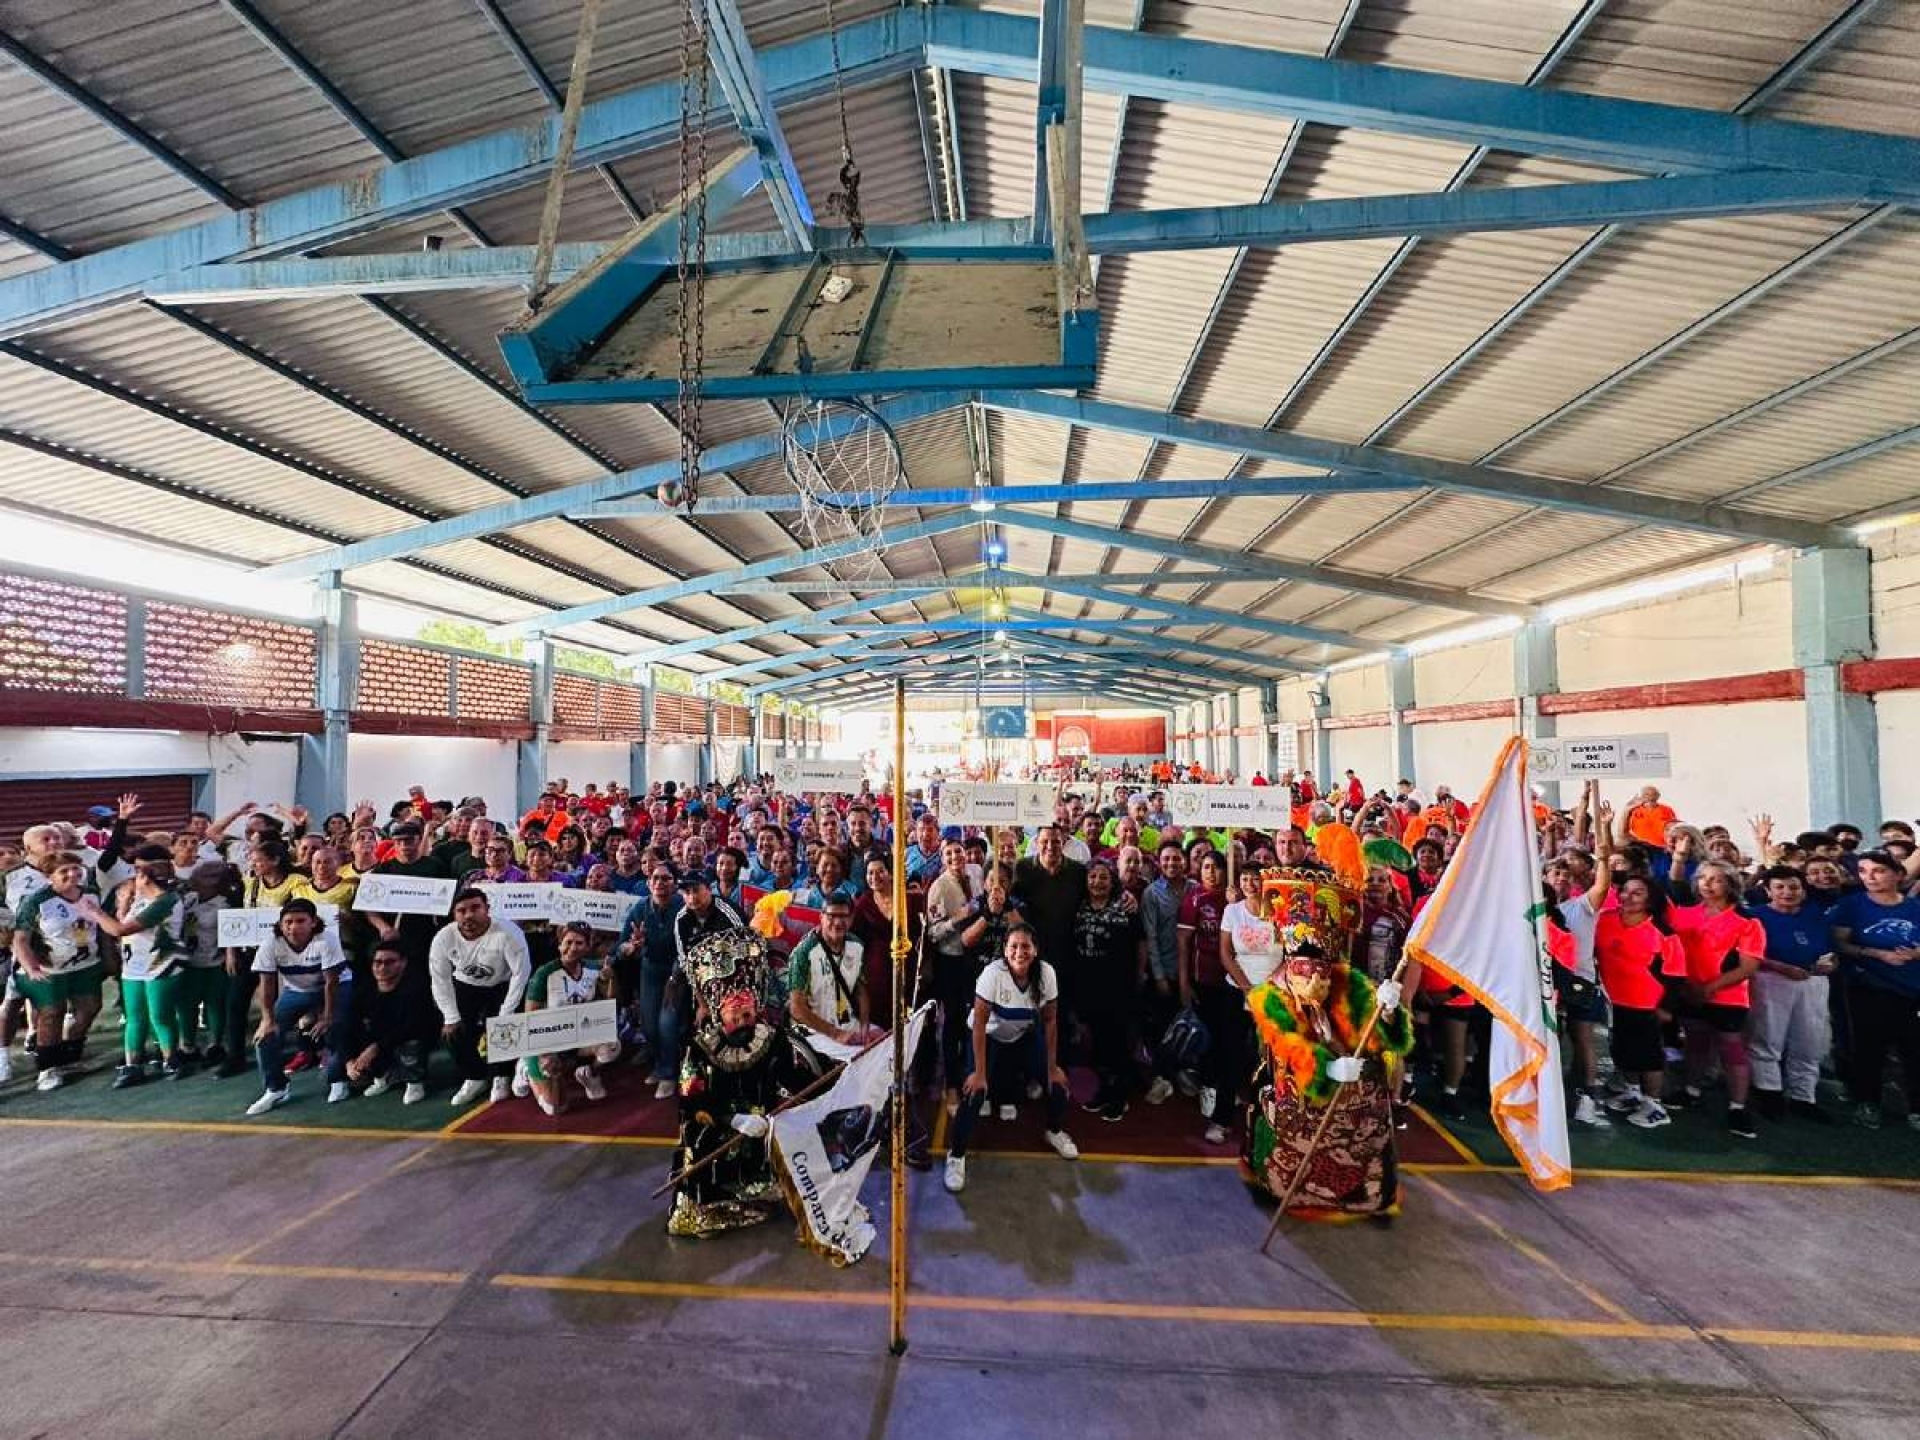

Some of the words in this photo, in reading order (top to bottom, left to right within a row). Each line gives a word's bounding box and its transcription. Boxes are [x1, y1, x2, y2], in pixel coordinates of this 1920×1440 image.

[1571, 745, 1614, 753] ESTADO
[56, 903, 69, 919] 3
[528, 1023, 575, 1036] MORELOS
